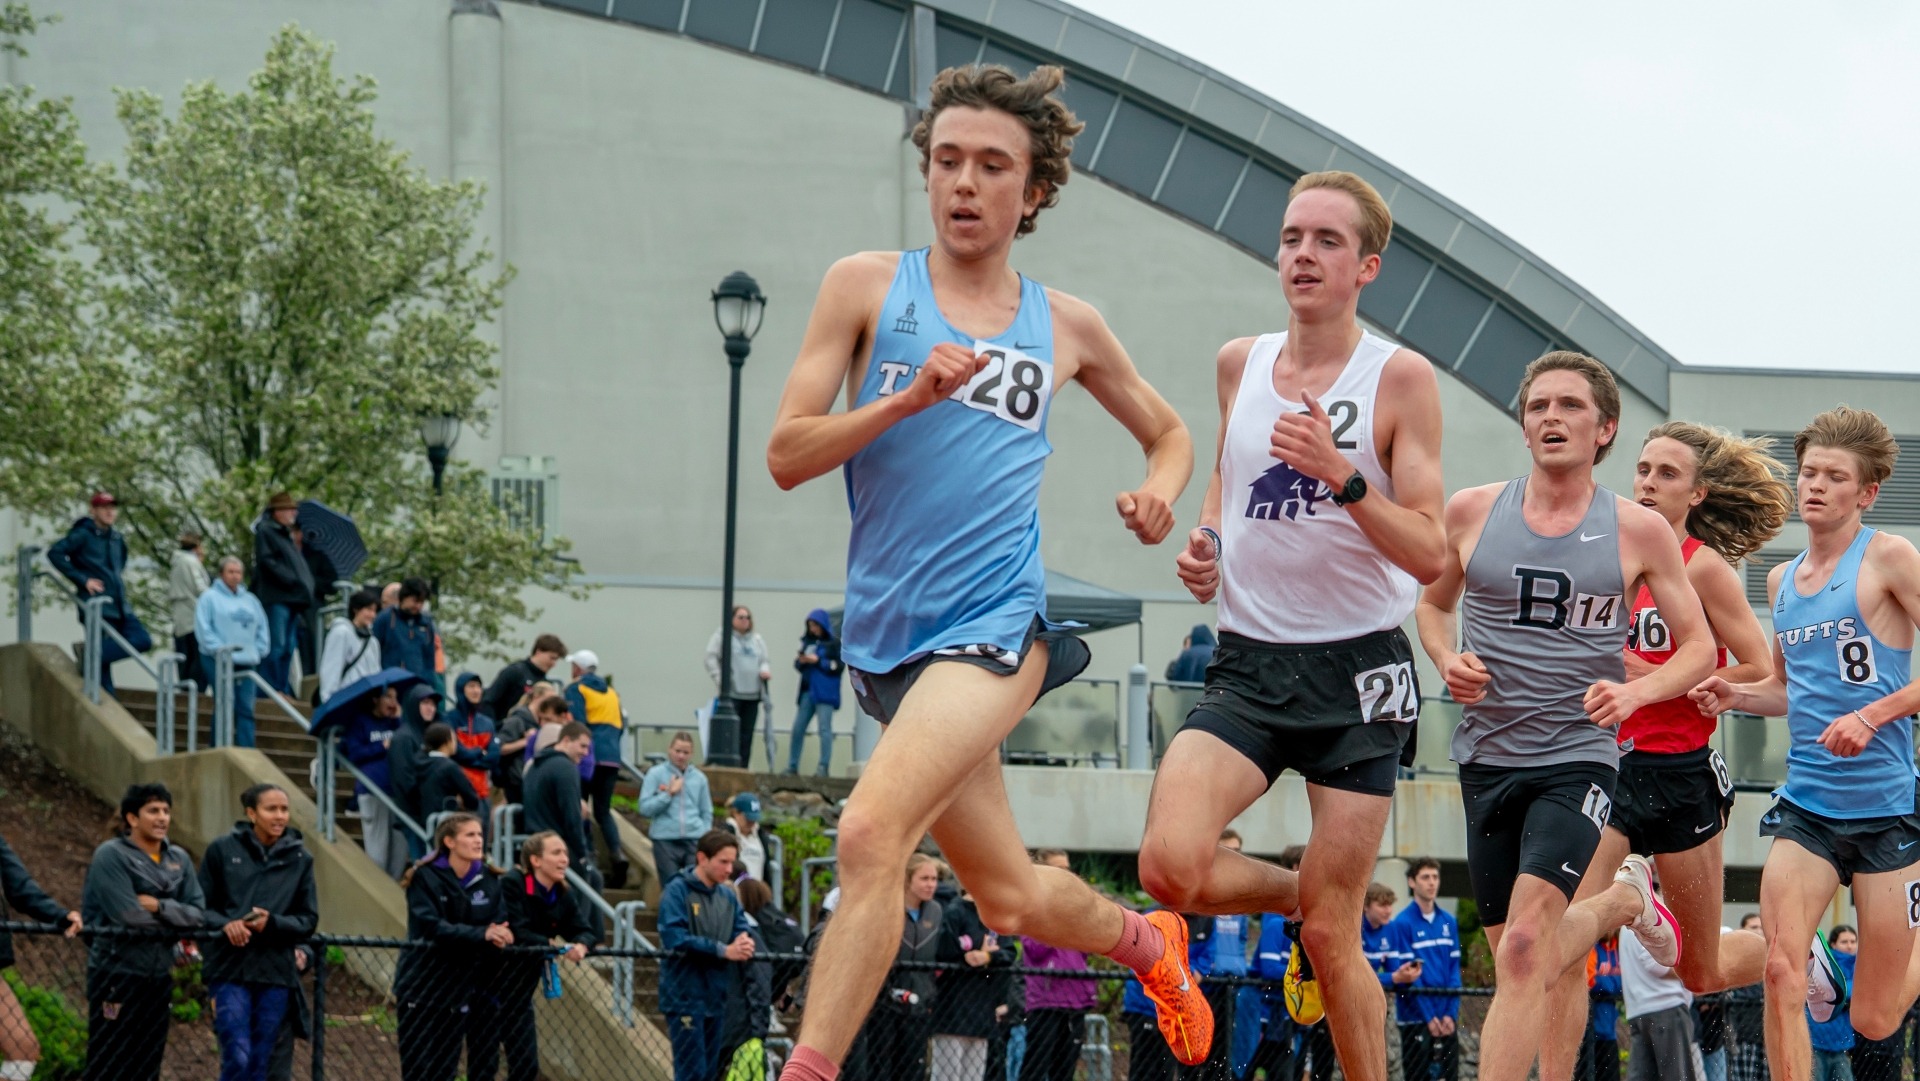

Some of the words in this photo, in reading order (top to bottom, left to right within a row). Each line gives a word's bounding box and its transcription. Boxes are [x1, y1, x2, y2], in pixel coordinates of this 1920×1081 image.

[970, 349, 1044, 421] 28
[1508, 563, 1575, 633] B
[1579, 596, 1616, 627] 14
[1644, 610, 1666, 648] 6
[1842, 641, 1871, 682] 8
[1363, 667, 1415, 722] 22
[1713, 753, 1729, 790] 6
[1590, 788, 1611, 831] 14
[1910, 882, 1920, 923] 8
